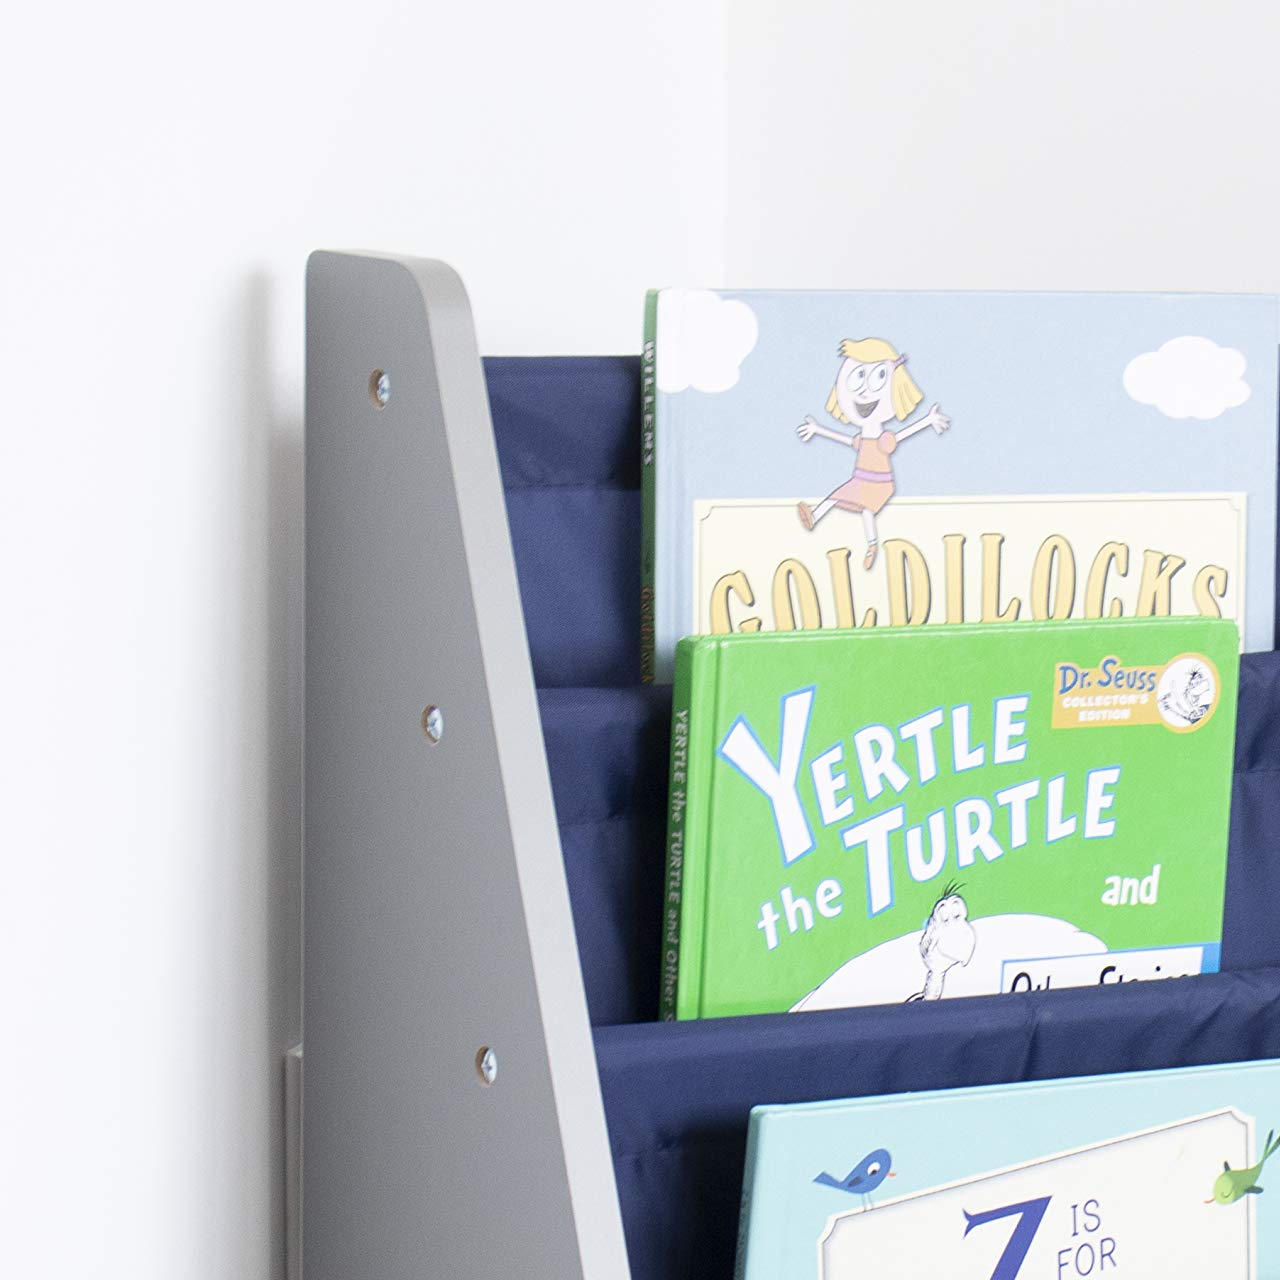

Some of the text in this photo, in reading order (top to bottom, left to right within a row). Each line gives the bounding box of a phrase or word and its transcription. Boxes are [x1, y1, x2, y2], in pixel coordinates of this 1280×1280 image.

[1058, 658, 1157, 695] Dr. Seuss
[1077, 708, 1131, 722] EDITION
[672, 709, 689, 784] YERTLE
[716, 683, 1031, 868] YERTLE
[671, 788, 686, 824] the
[669, 829, 684, 904] TURTLE
[756, 764, 1122, 951] the TURTLE
[1101, 863, 1162, 906] and
[666, 908, 680, 945] and
[1070, 1198, 1102, 1238] IS
